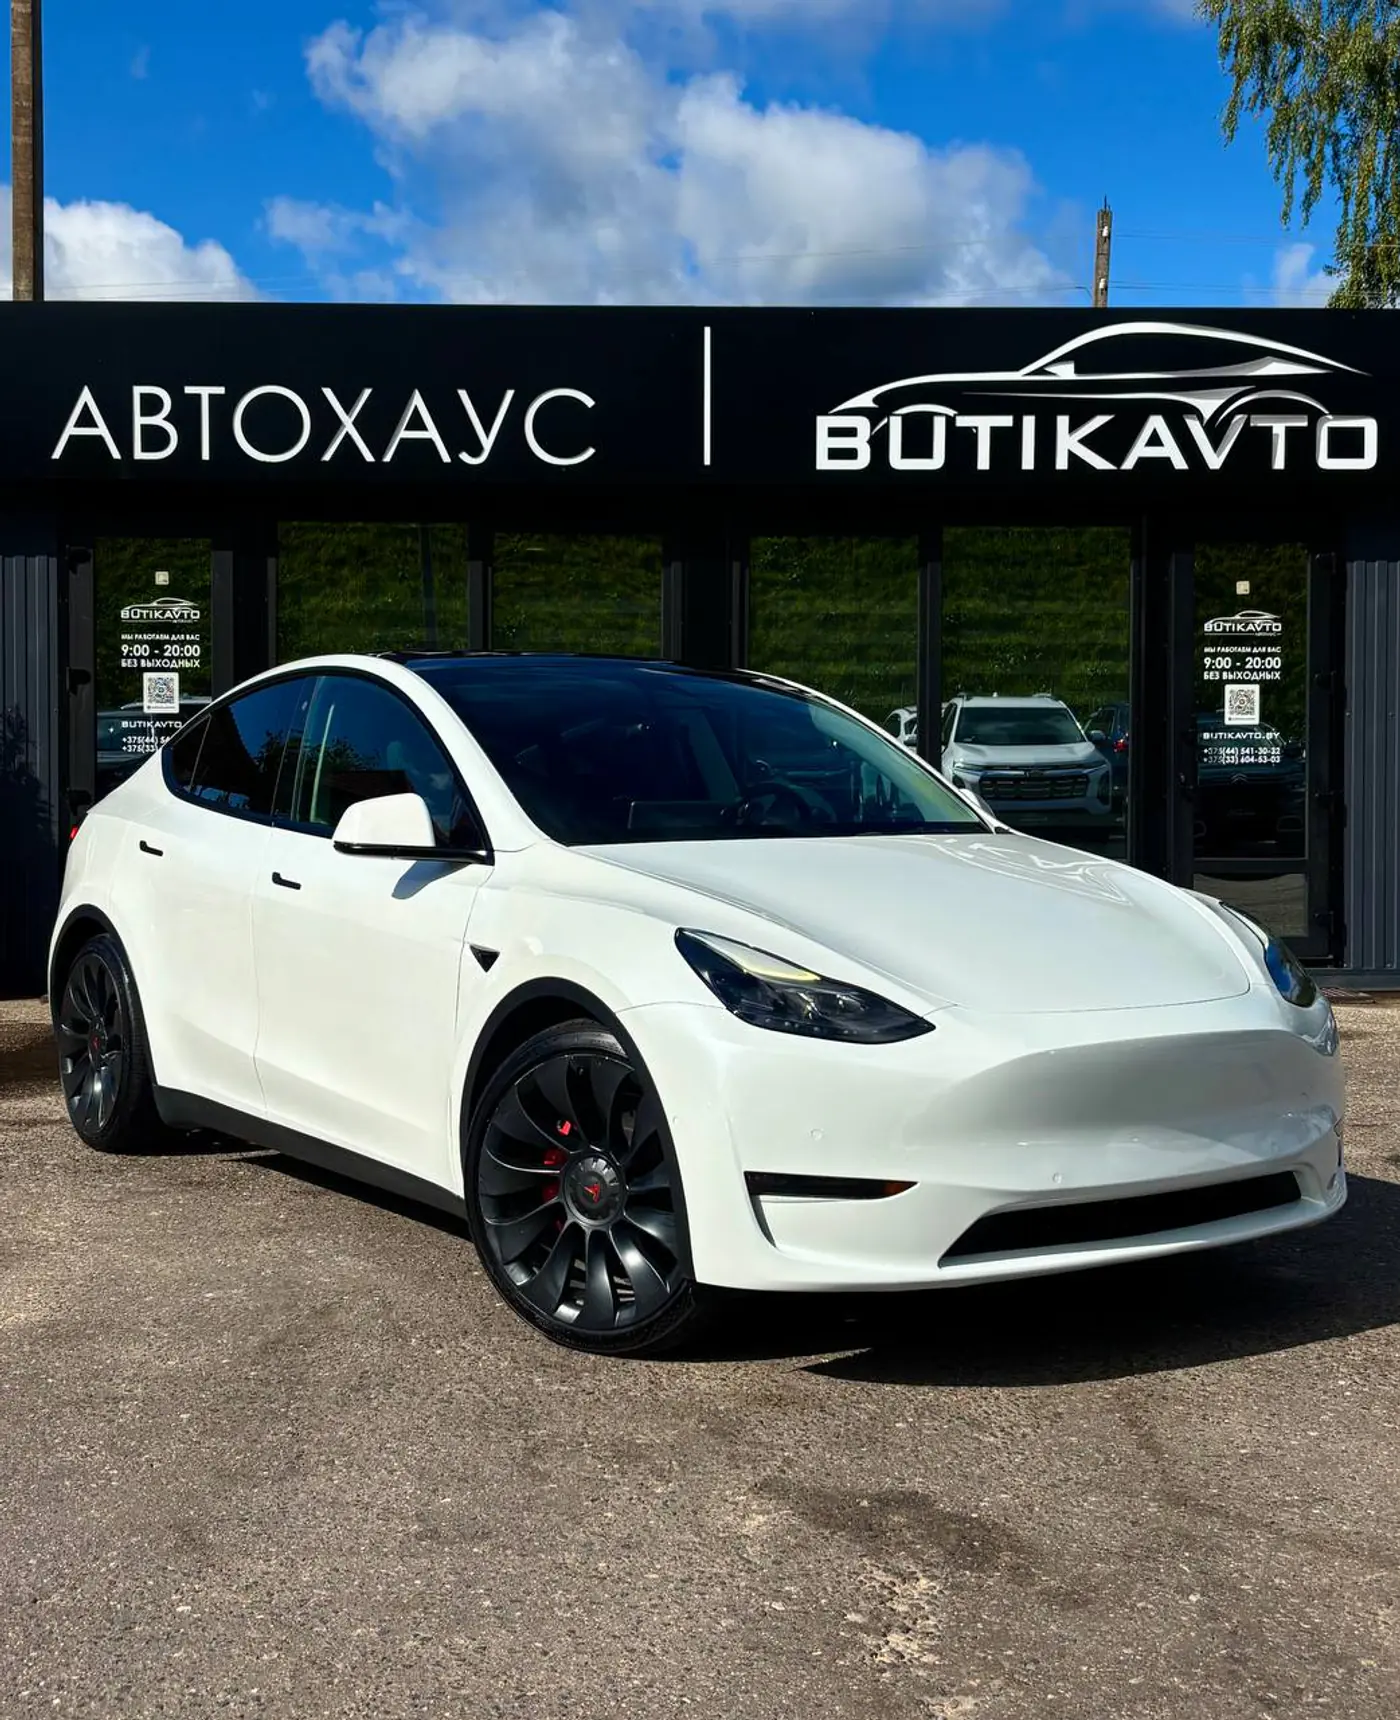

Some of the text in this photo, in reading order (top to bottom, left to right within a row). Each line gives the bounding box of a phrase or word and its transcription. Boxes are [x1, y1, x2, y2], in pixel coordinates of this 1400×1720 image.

[51, 384, 597, 467] АВТОХАУС
[815, 414, 1378, 471] BUTIKAVTO
[120, 608, 200, 619] BUTIKAVTO
[1203, 622, 1282, 632] BUTIKAVTO
[121, 644, 150, 656] 9:00
[163, 644, 201, 657] 20:00
[121, 658, 201, 669] БЕЗ ВЫХОДНЫХ
[1203, 656, 1232, 669] 9:00
[1244, 656, 1282, 669] 20:00
[1203, 671, 1282, 681] БЕЗ ВЫХОДНЫХ
[1203, 732, 1281, 740] BUTIKAVTO.BY
